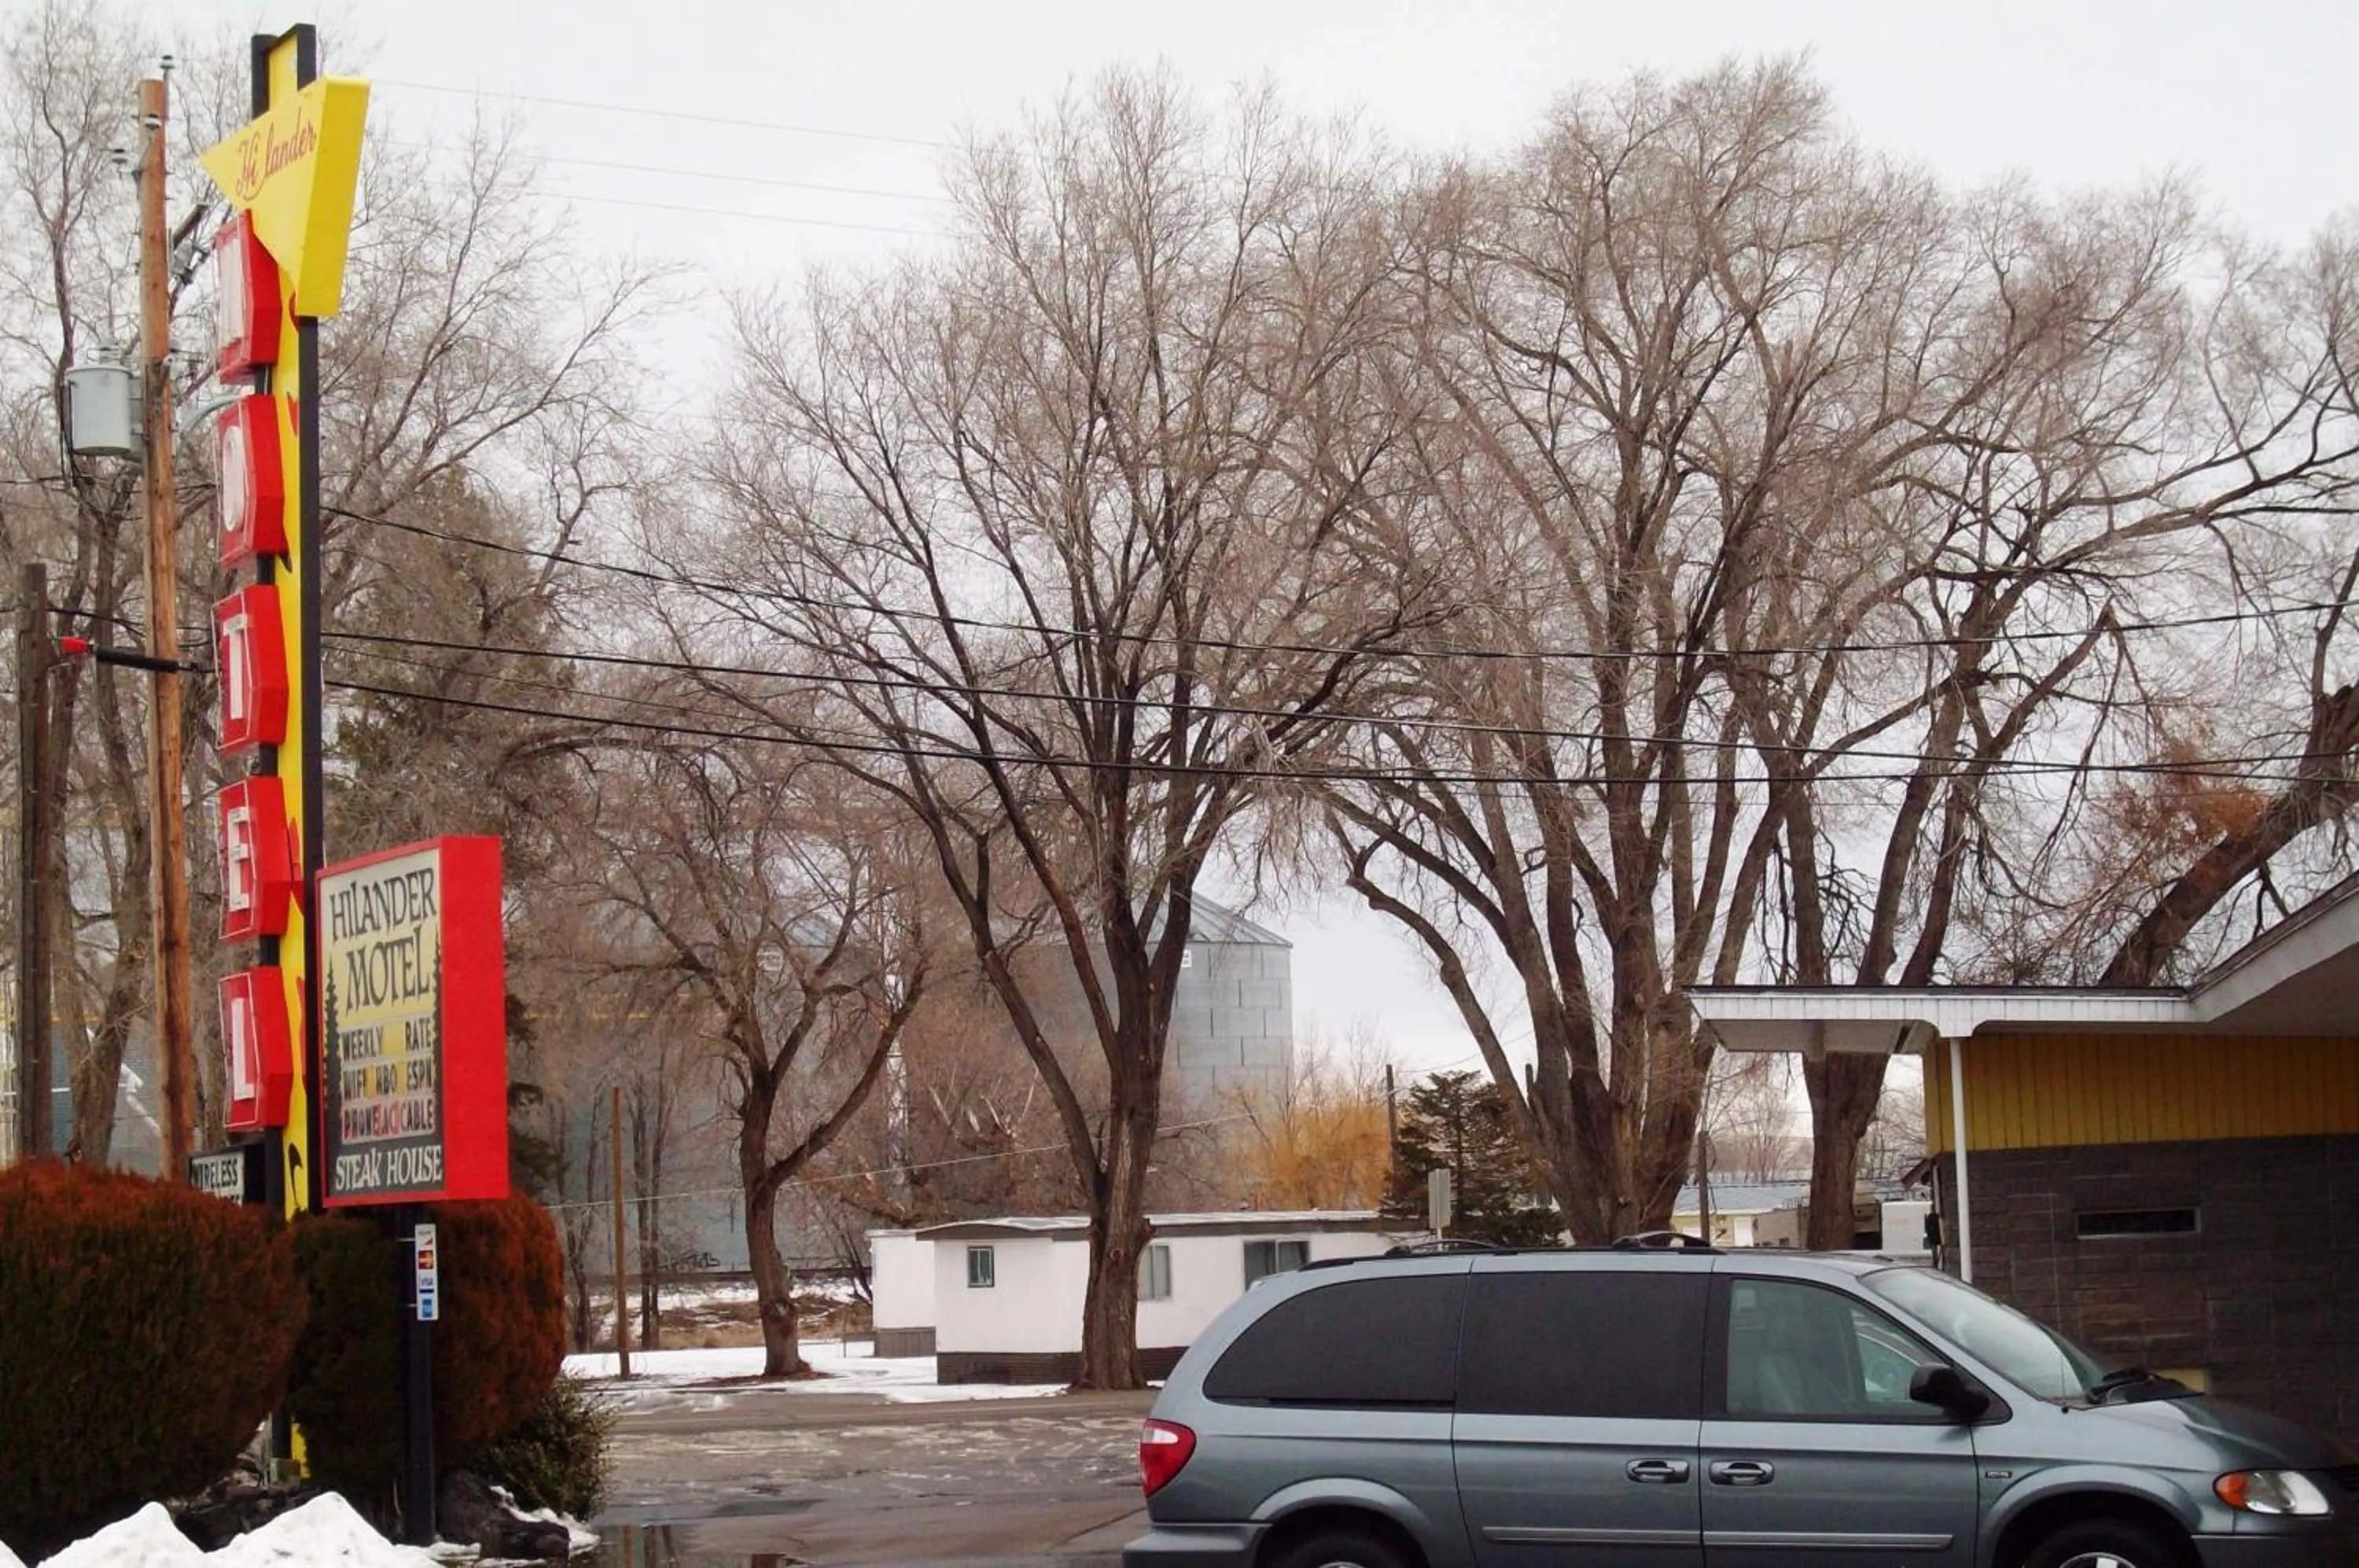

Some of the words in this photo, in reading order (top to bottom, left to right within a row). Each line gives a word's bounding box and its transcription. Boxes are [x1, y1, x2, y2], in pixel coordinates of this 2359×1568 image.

[219, 237, 256, 1101] MOTEL
[329, 867, 437, 944] HILANDER
[345, 925, 430, 1018] MOTEL
[341, 1025, 383, 1062] WEEKLY
[405, 1017, 432, 1052] RATE
[375, 1062, 397, 1095] HBO
[407, 1057, 432, 1091] ESPN
[344, 1104, 380, 1140] PHONE
[399, 1099, 432, 1132] CABLE
[192, 1158, 238, 1190] WIRELESS
[386, 1145, 443, 1187] HOUSE
